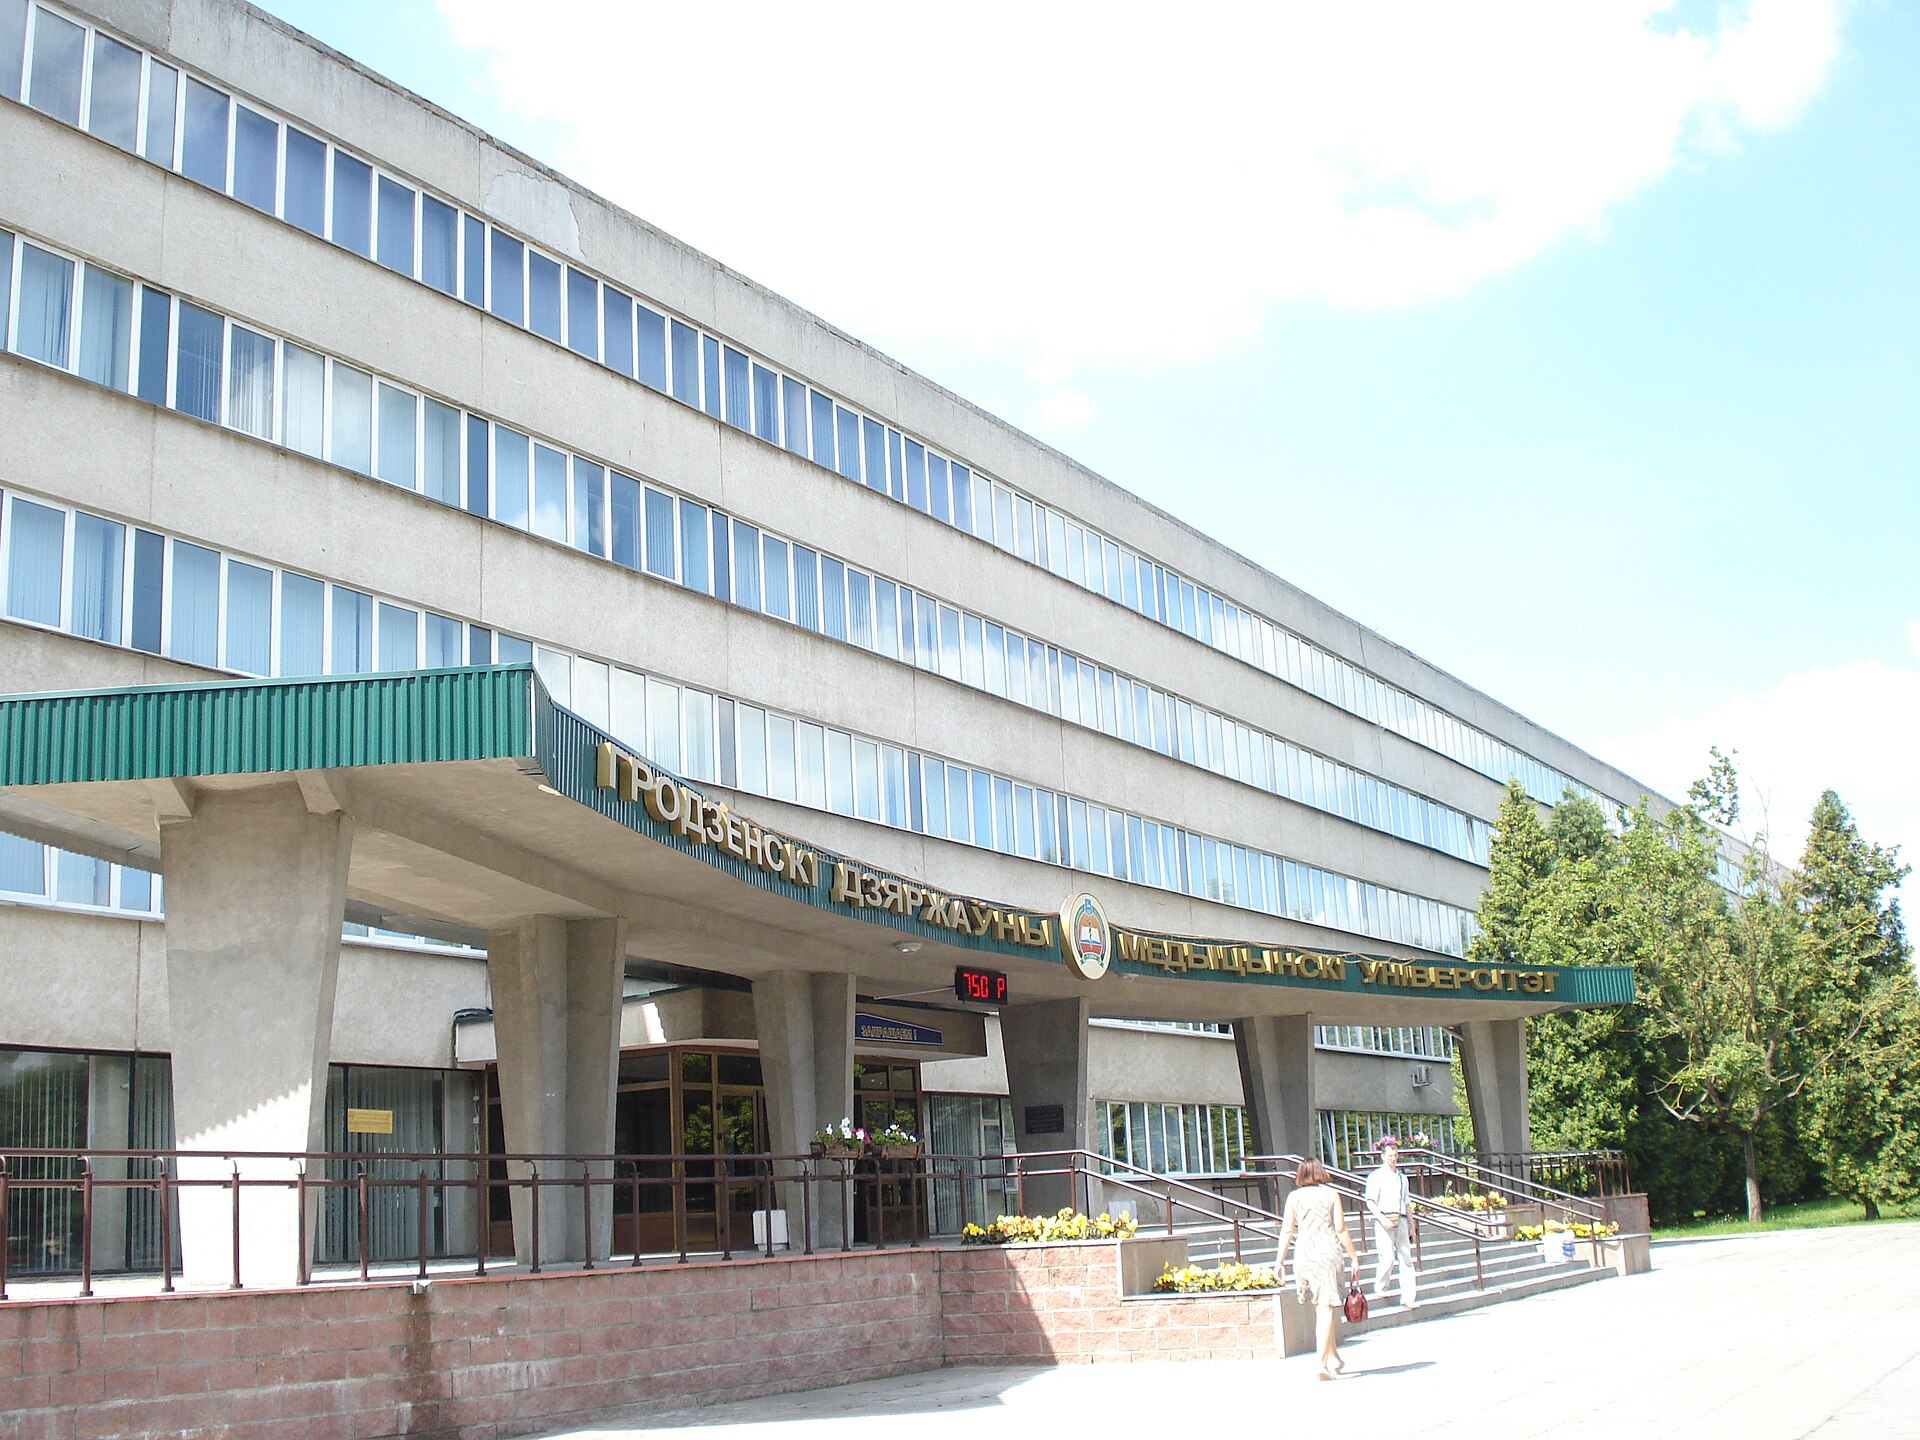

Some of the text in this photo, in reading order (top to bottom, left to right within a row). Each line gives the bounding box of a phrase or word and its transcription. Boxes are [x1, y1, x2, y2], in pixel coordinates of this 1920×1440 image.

[597, 741, 818, 887] ГРОДЗЕНСКІ
[1117, 933, 1346, 980] МЕДЫЦЫНСКІ
[1360, 961, 1560, 993] УНІВЕРСІТЭТ
[963, 973, 989, 998] 750
